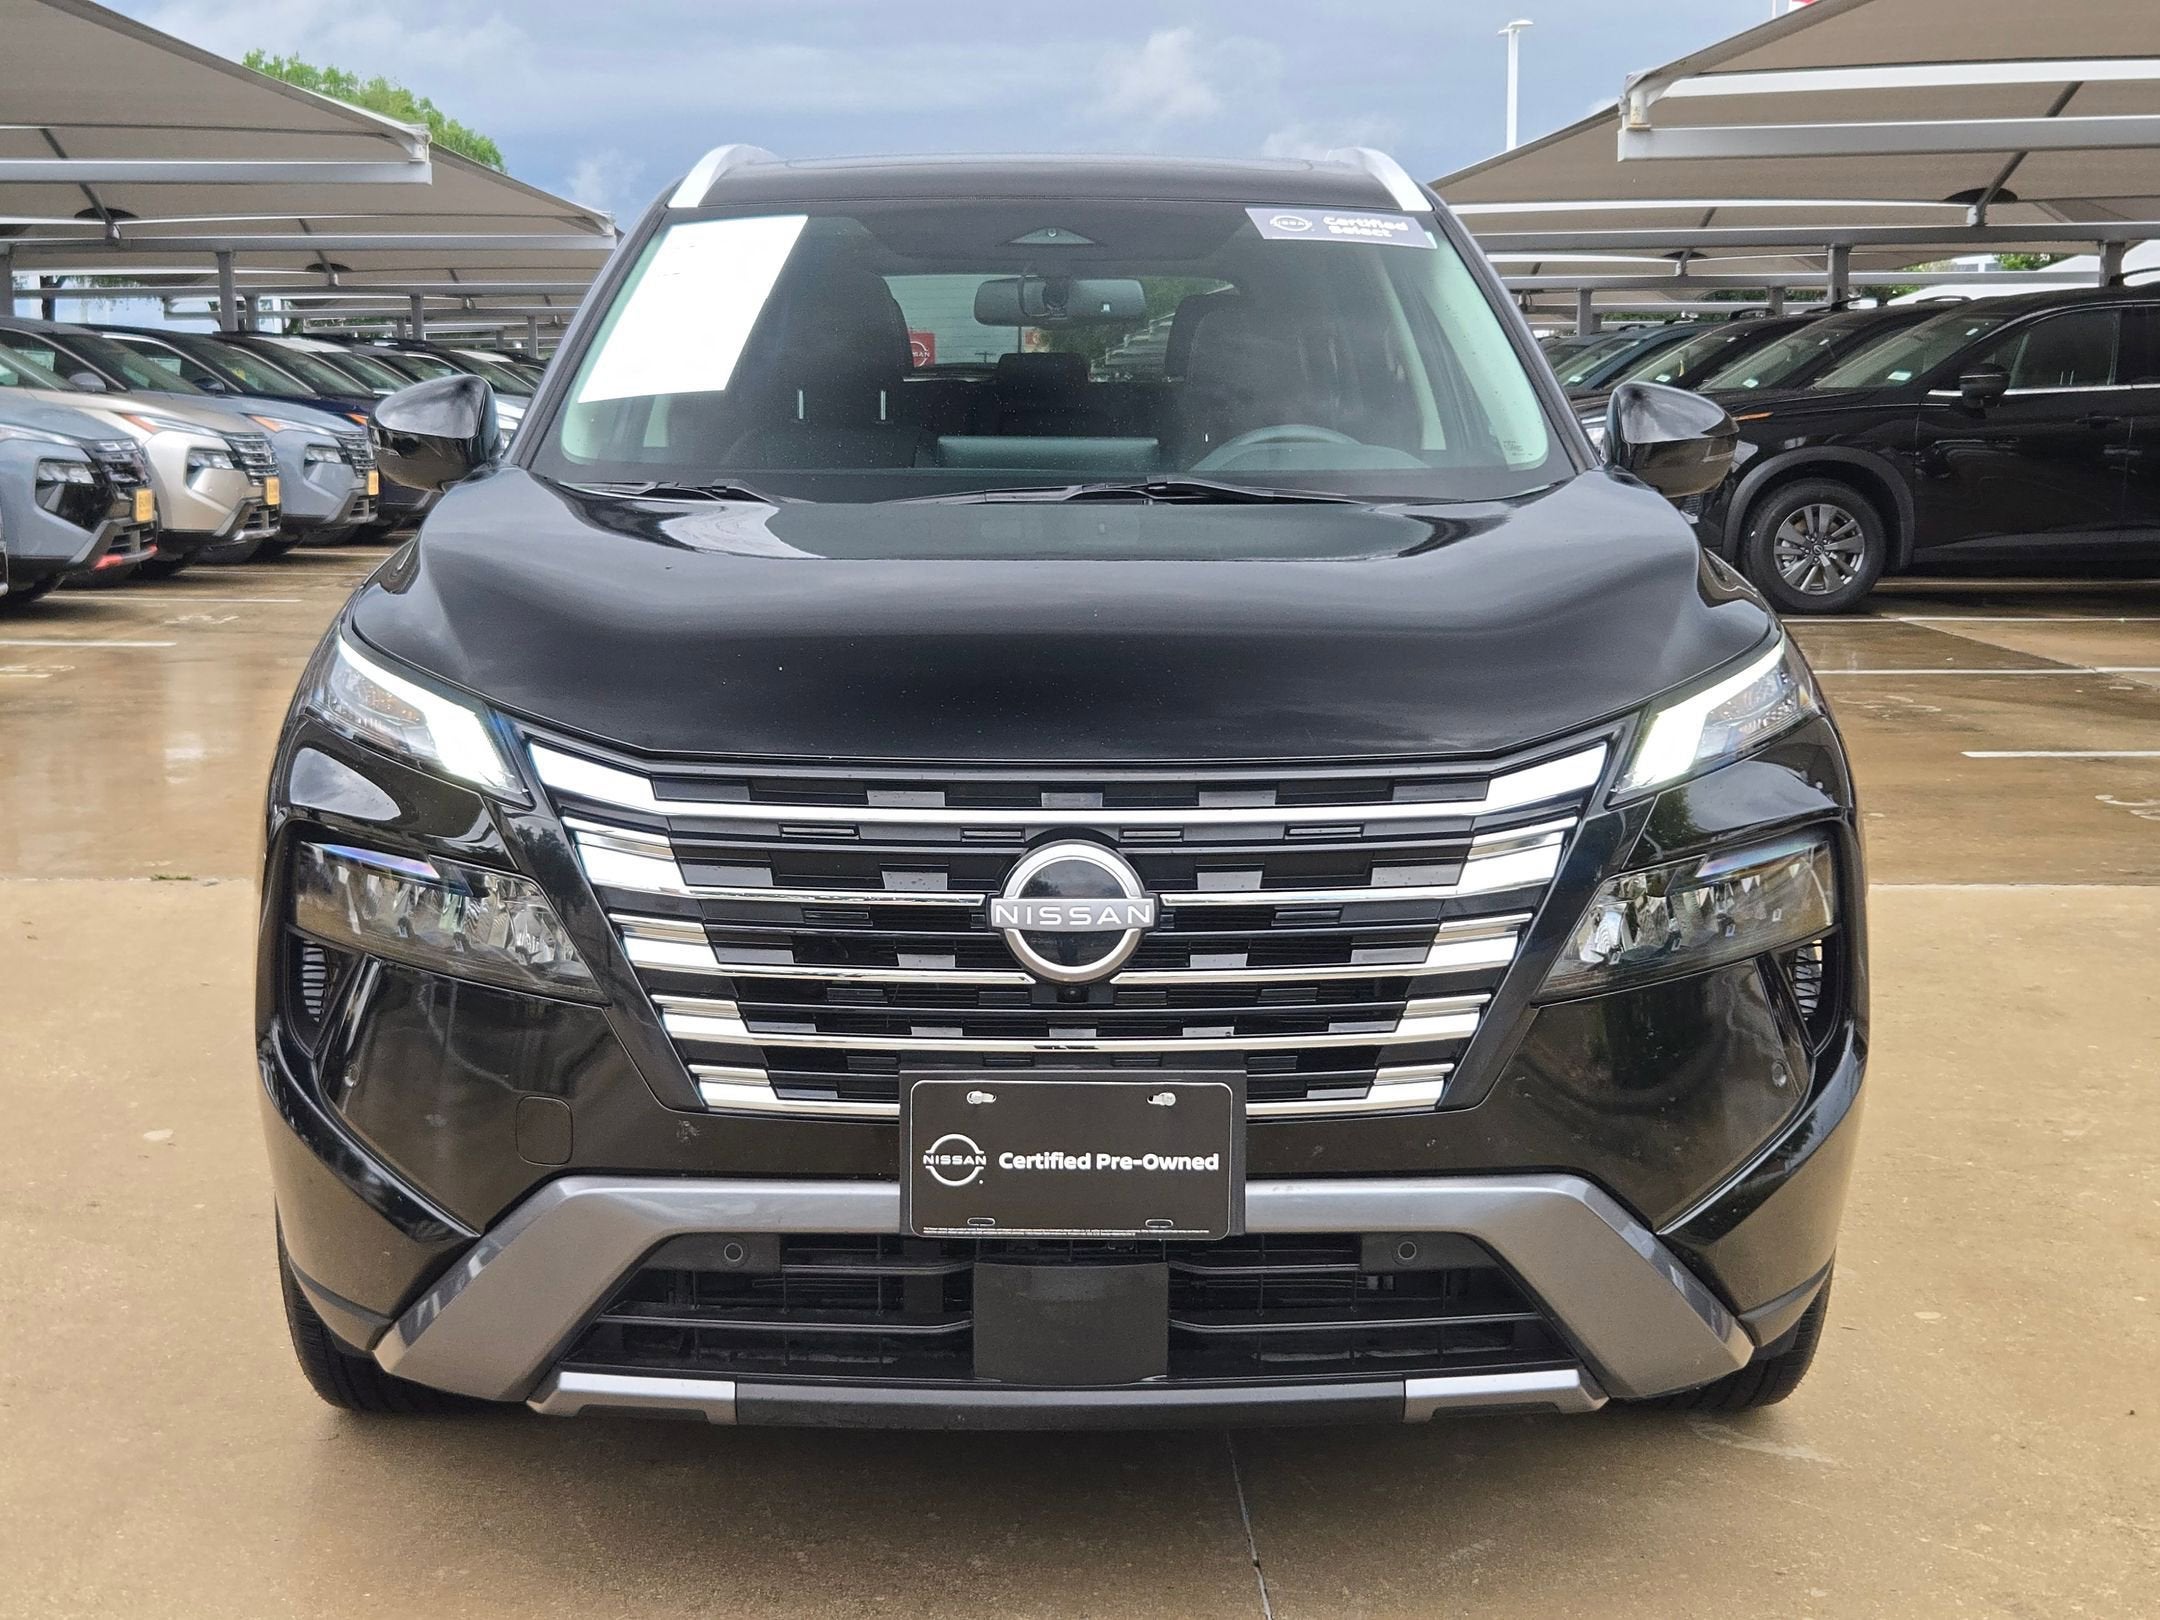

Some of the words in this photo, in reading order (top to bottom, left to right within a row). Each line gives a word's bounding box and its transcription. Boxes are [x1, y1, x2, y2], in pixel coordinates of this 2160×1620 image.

[1323, 217, 1408, 231] Certified
[995, 905, 1151, 925] NISSAN
[923, 1154, 987, 1166] NISSAN
[998, 1151, 1091, 1170] Certified
[1096, 1152, 1219, 1171] Pre-Owned
